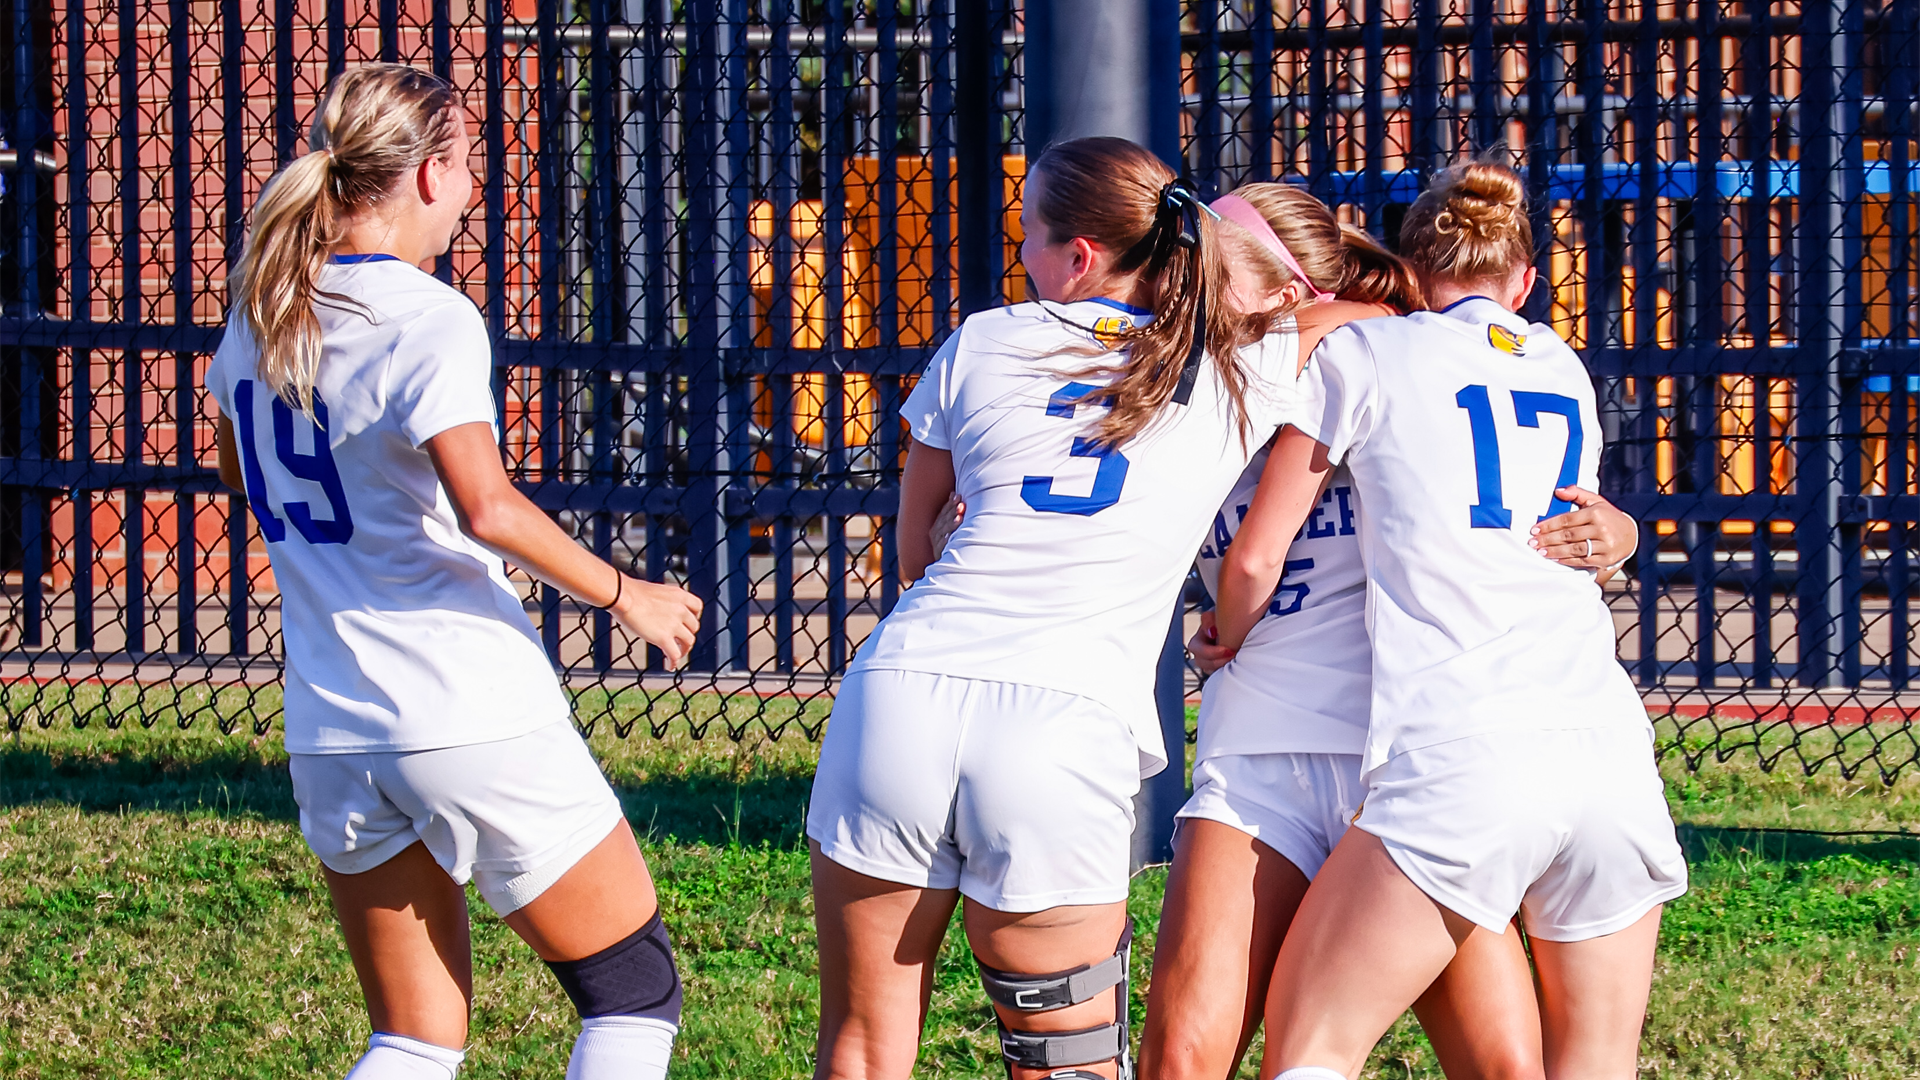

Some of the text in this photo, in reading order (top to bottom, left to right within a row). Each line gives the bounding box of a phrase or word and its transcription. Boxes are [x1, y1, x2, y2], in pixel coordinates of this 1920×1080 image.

[234, 379, 354, 545] 19
[1020, 381, 1136, 517] 3
[1455, 384, 1584, 530] 17
